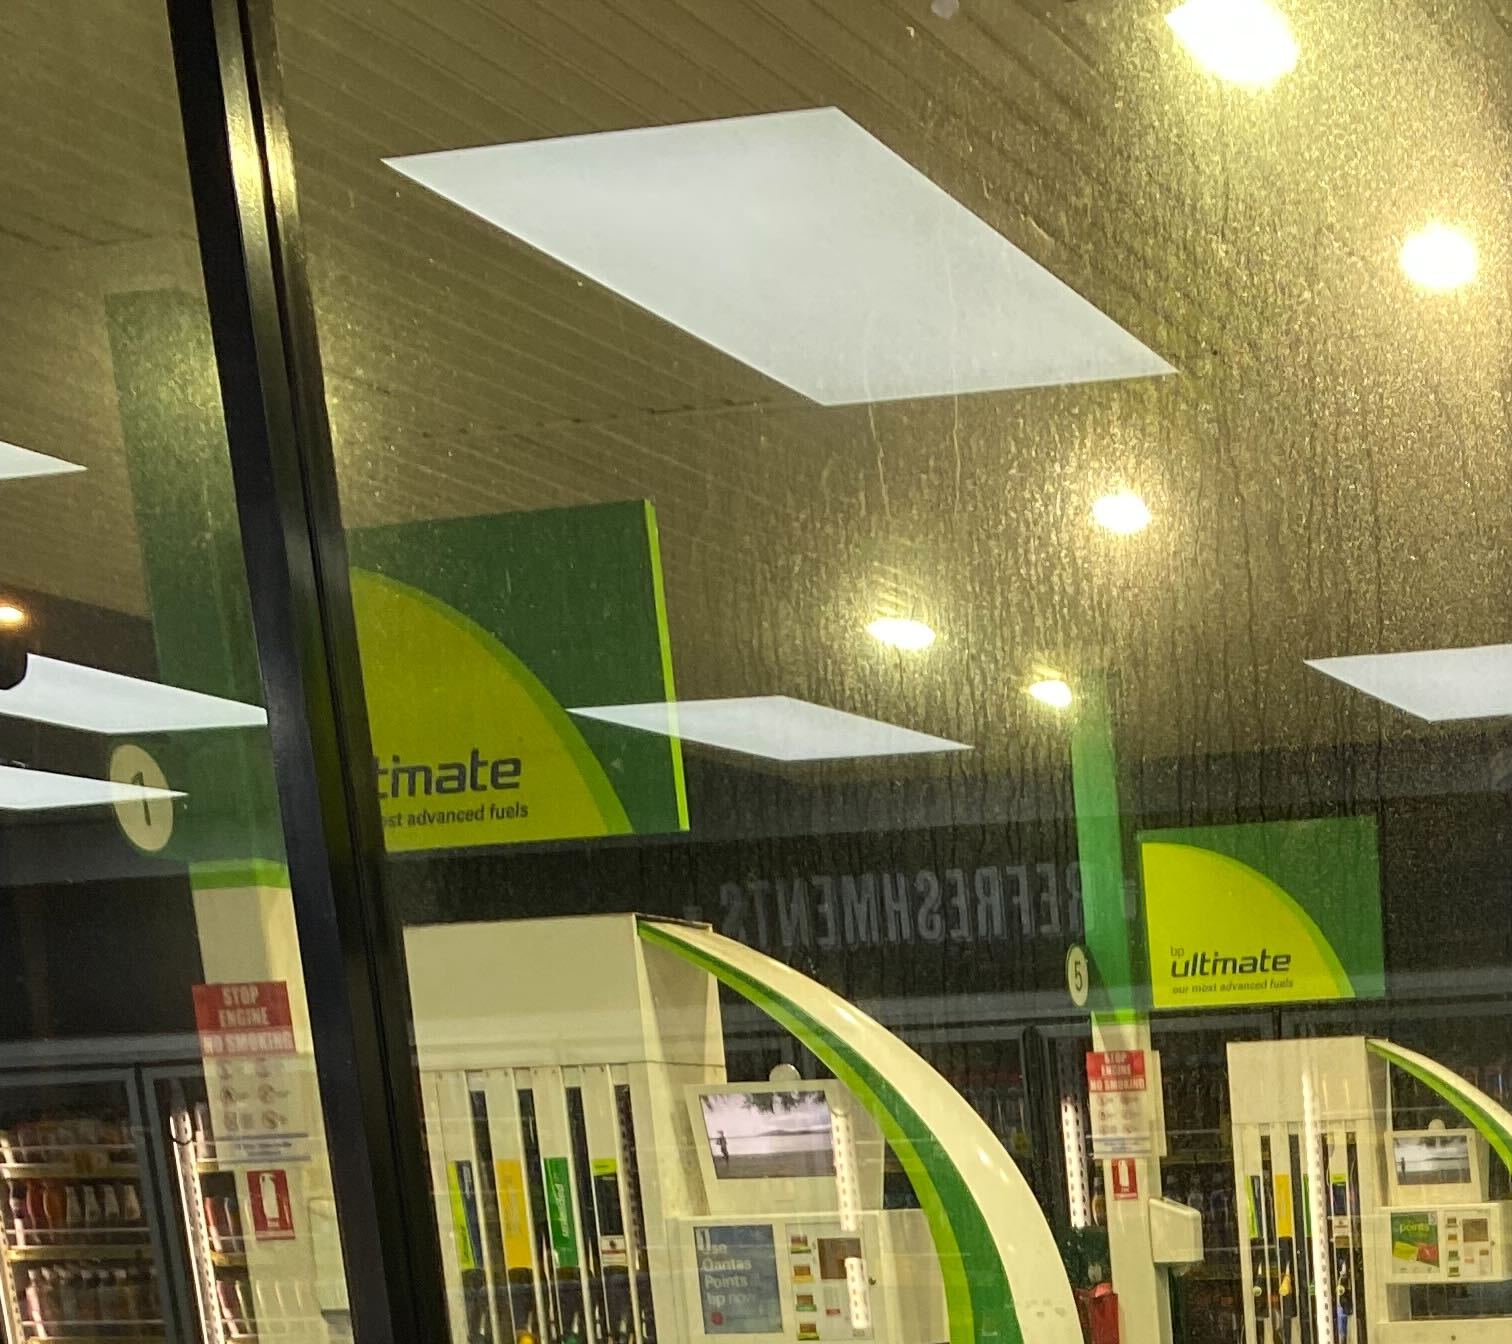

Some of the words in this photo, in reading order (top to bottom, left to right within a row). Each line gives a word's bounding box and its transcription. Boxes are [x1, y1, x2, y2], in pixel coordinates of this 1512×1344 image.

[407, 804, 485, 826] advanced
[490, 801, 529, 820] fuels
[1170, 946, 1185, 958] bp
[1171, 948, 1292, 978] ultimate
[1074, 960, 1083, 992] 5
[221, 986, 260, 1006] STOP
[1172, 984, 1189, 994] our
[1192, 982, 1217, 993] most
[1220, 981, 1267, 992] advanced
[1269, 979, 1294, 990] fuels
[217, 1006, 271, 1028] ENGINE
[701, 1257, 752, 1272] Qantas
[704, 1274, 749, 1289] Points
